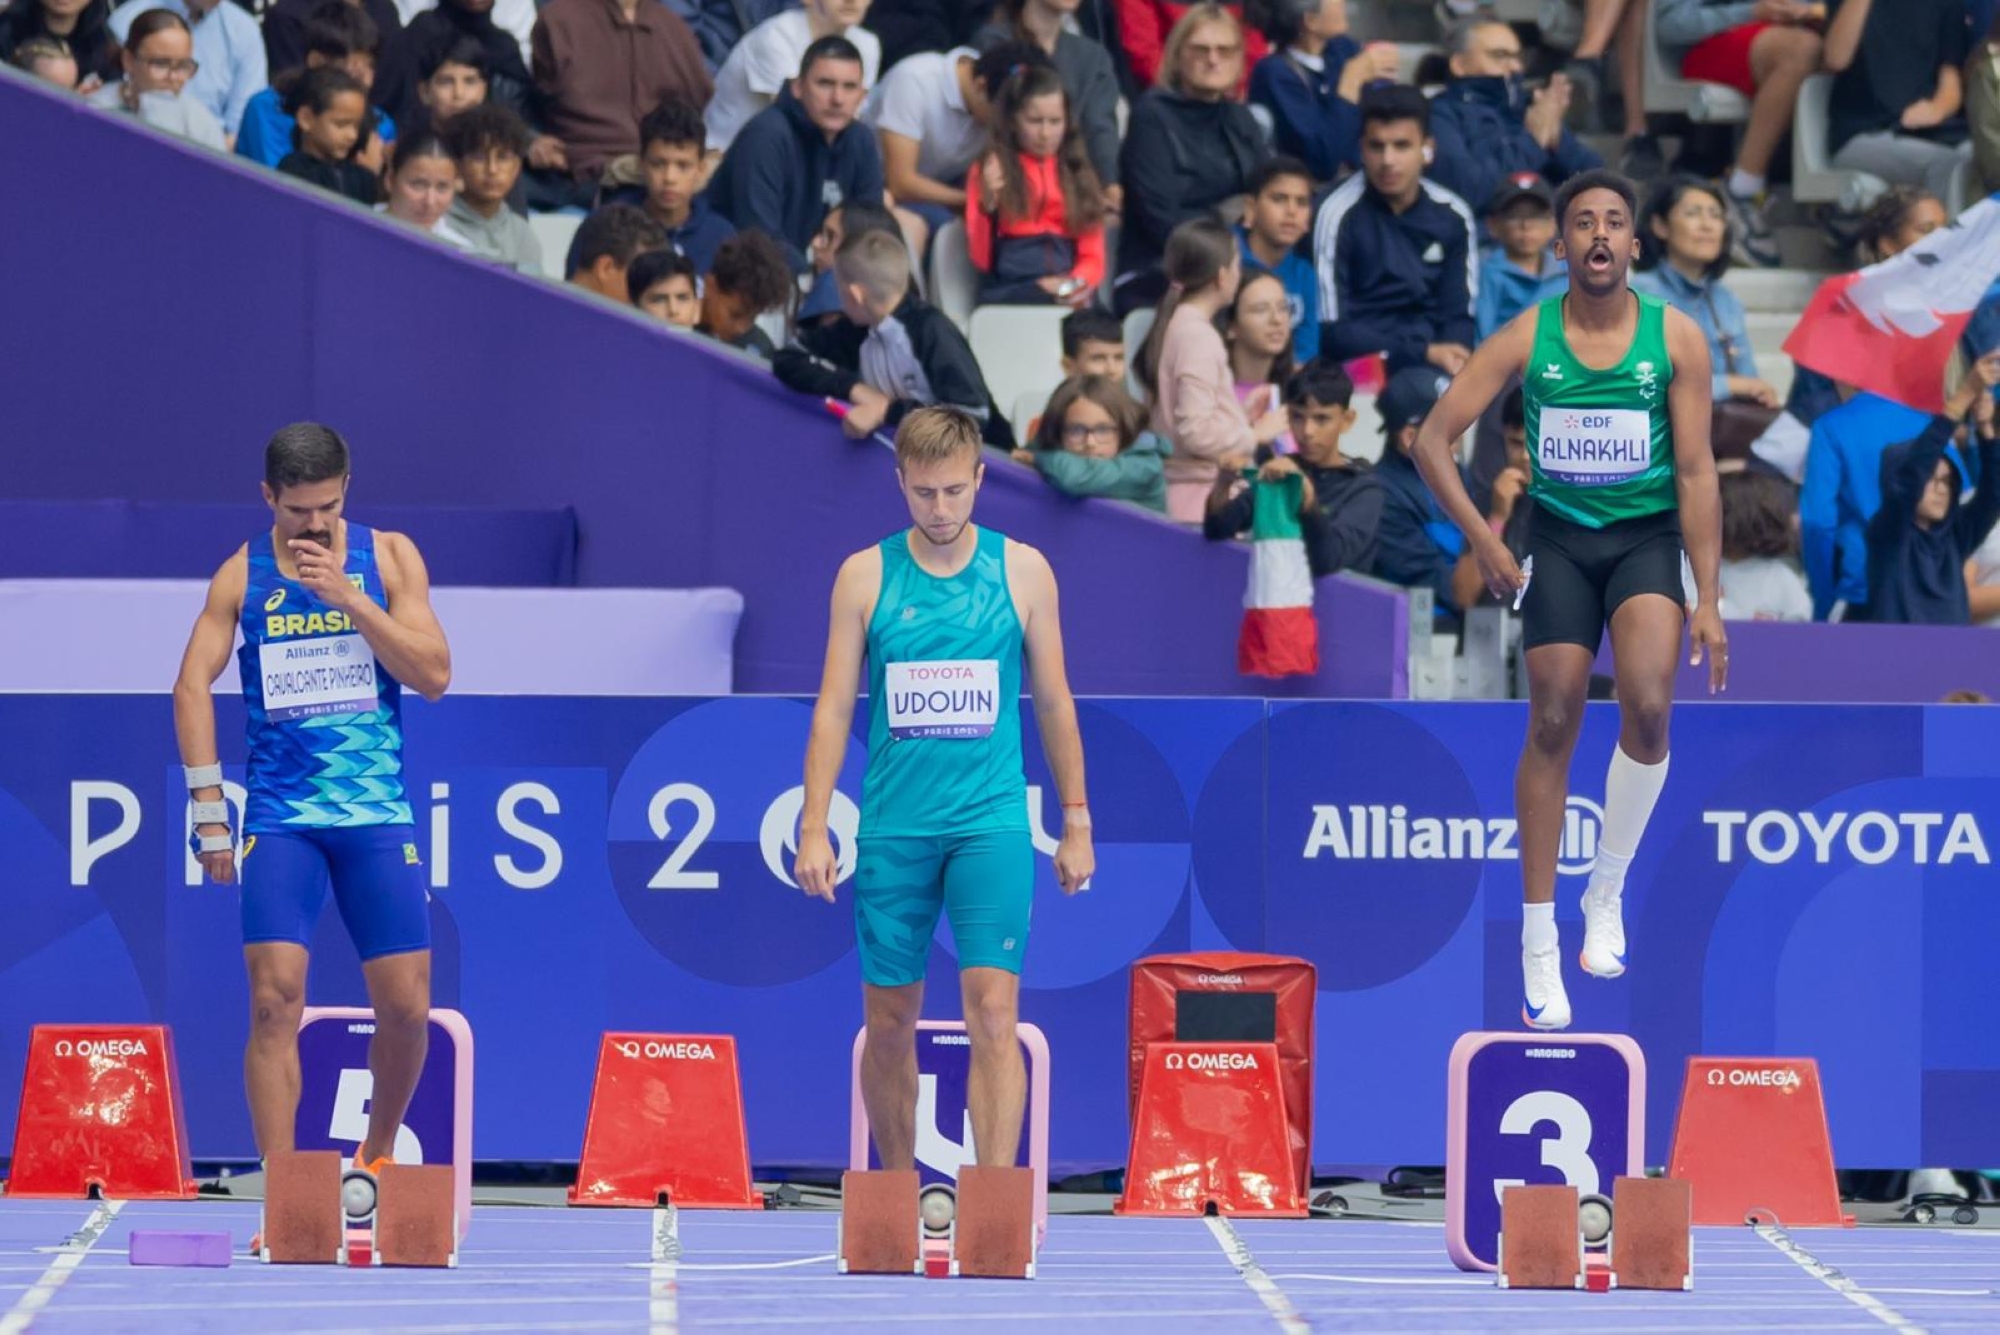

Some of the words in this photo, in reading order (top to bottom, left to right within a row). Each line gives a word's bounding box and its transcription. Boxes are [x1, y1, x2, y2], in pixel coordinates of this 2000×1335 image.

[1543, 437, 1645, 462] ALNAKHLI
[267, 610, 358, 637] BRASI
[285, 645, 330, 660] Allianz
[908, 667, 974, 680] TOYOTA
[894, 689, 992, 715] UDOVIN
[1302, 803, 1519, 860] Allianz
[1702, 810, 1991, 865] TOYOTA
[1208, 974, 1243, 985] OMEGA
[76, 1040, 148, 1056] OMEGA
[644, 1041, 716, 1060] OMEGA
[1187, 1053, 1259, 1070] OMEGA
[1728, 1069, 1800, 1087] OMEGA
[1493, 1090, 1600, 1208] 3
